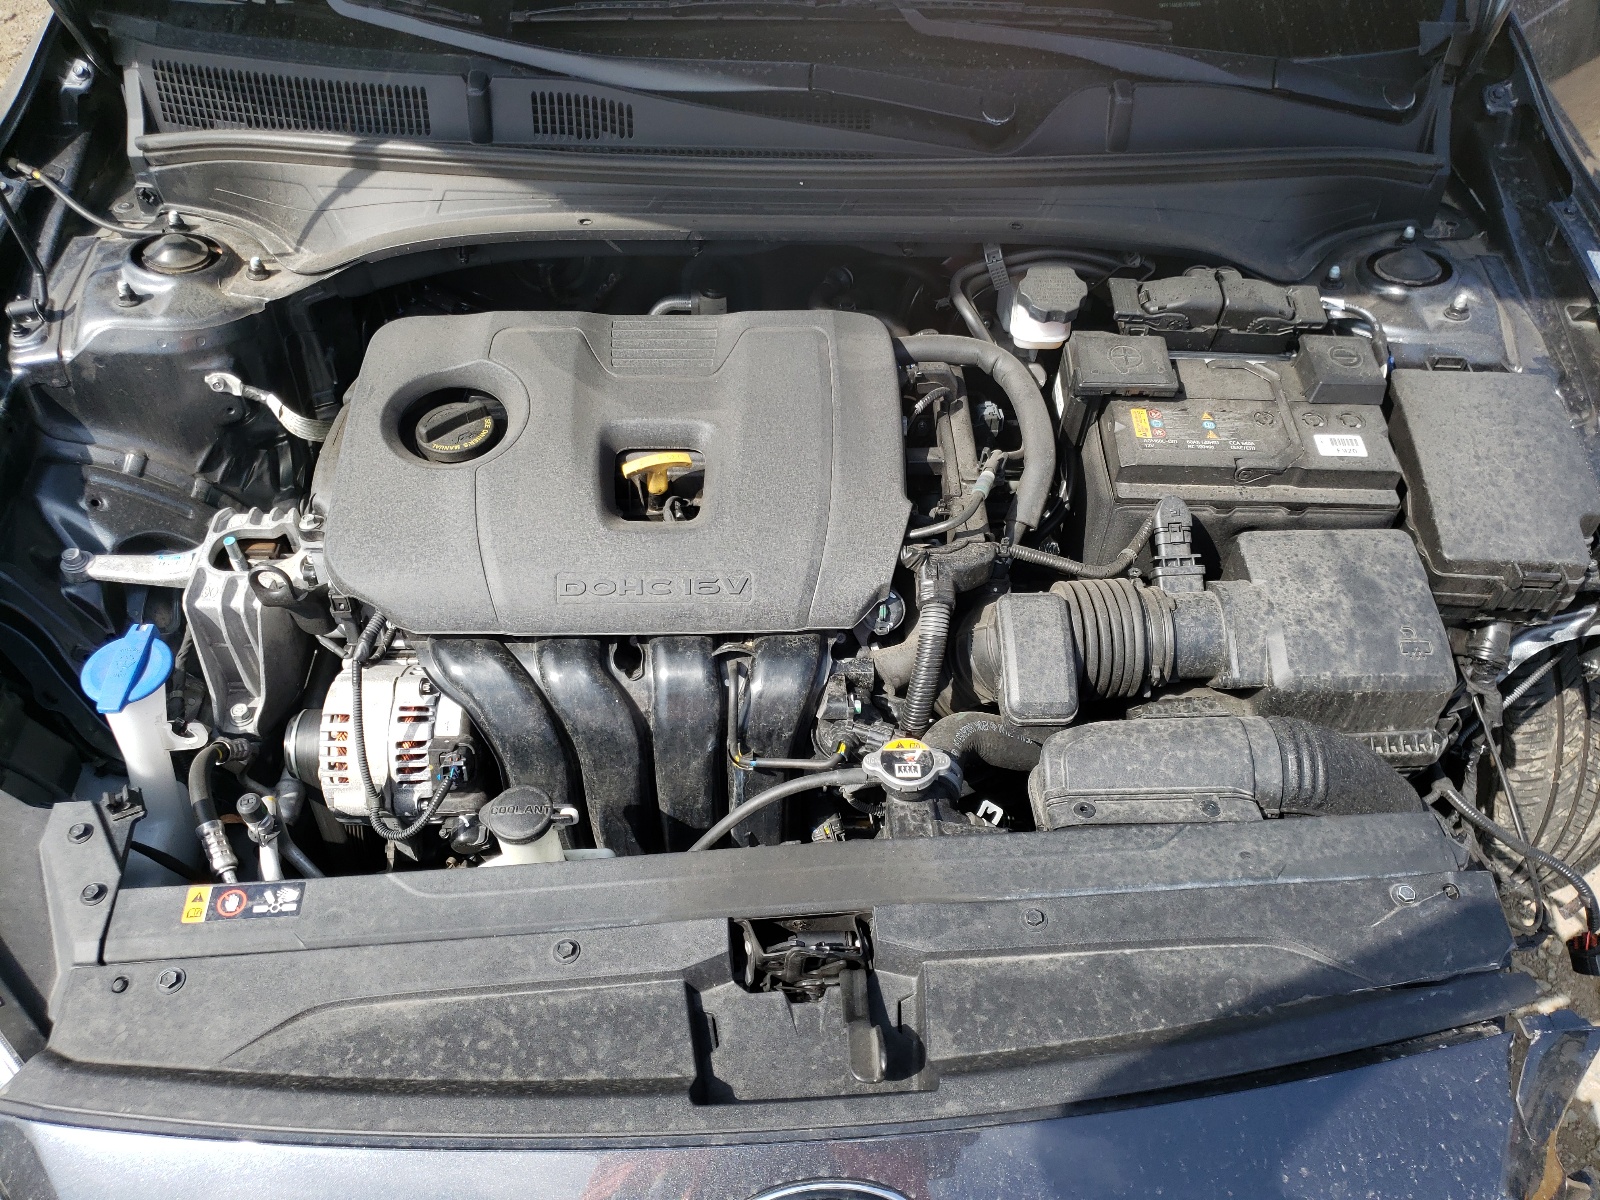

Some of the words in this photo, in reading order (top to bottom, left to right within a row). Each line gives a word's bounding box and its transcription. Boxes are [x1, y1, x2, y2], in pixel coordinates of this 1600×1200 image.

[484, 418, 492, 429] SEE
[464, 429, 489, 448] OWNER'S
[432, 443, 461, 451] MANUAL
[559, 578, 672, 596] DOHC
[491, 804, 551, 815] COOLANT
